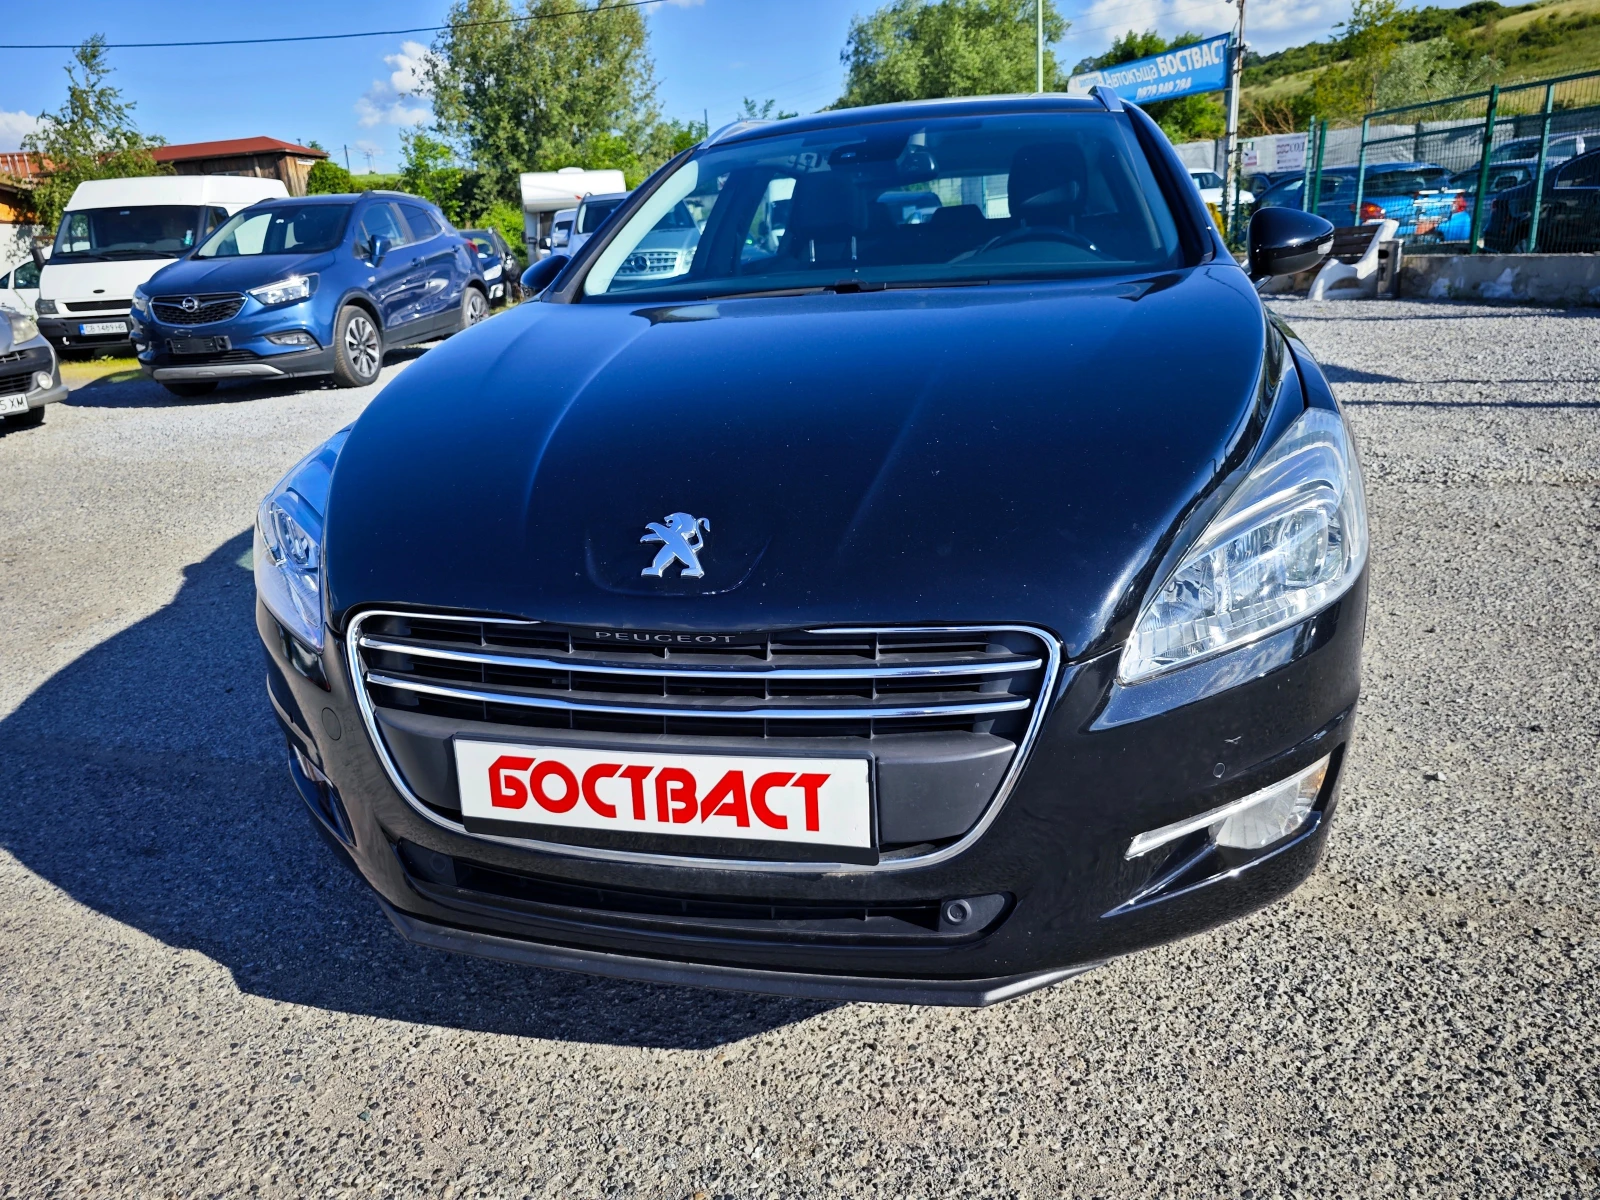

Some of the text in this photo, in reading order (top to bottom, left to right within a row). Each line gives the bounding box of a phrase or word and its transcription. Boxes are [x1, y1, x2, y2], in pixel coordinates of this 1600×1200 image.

[1103, 64, 1158, 88] Автокъща
[9, 396, 25, 409] XM
[595, 631, 736, 643] PEUGEOT
[488, 755, 831, 832] БОСТВАСТ
